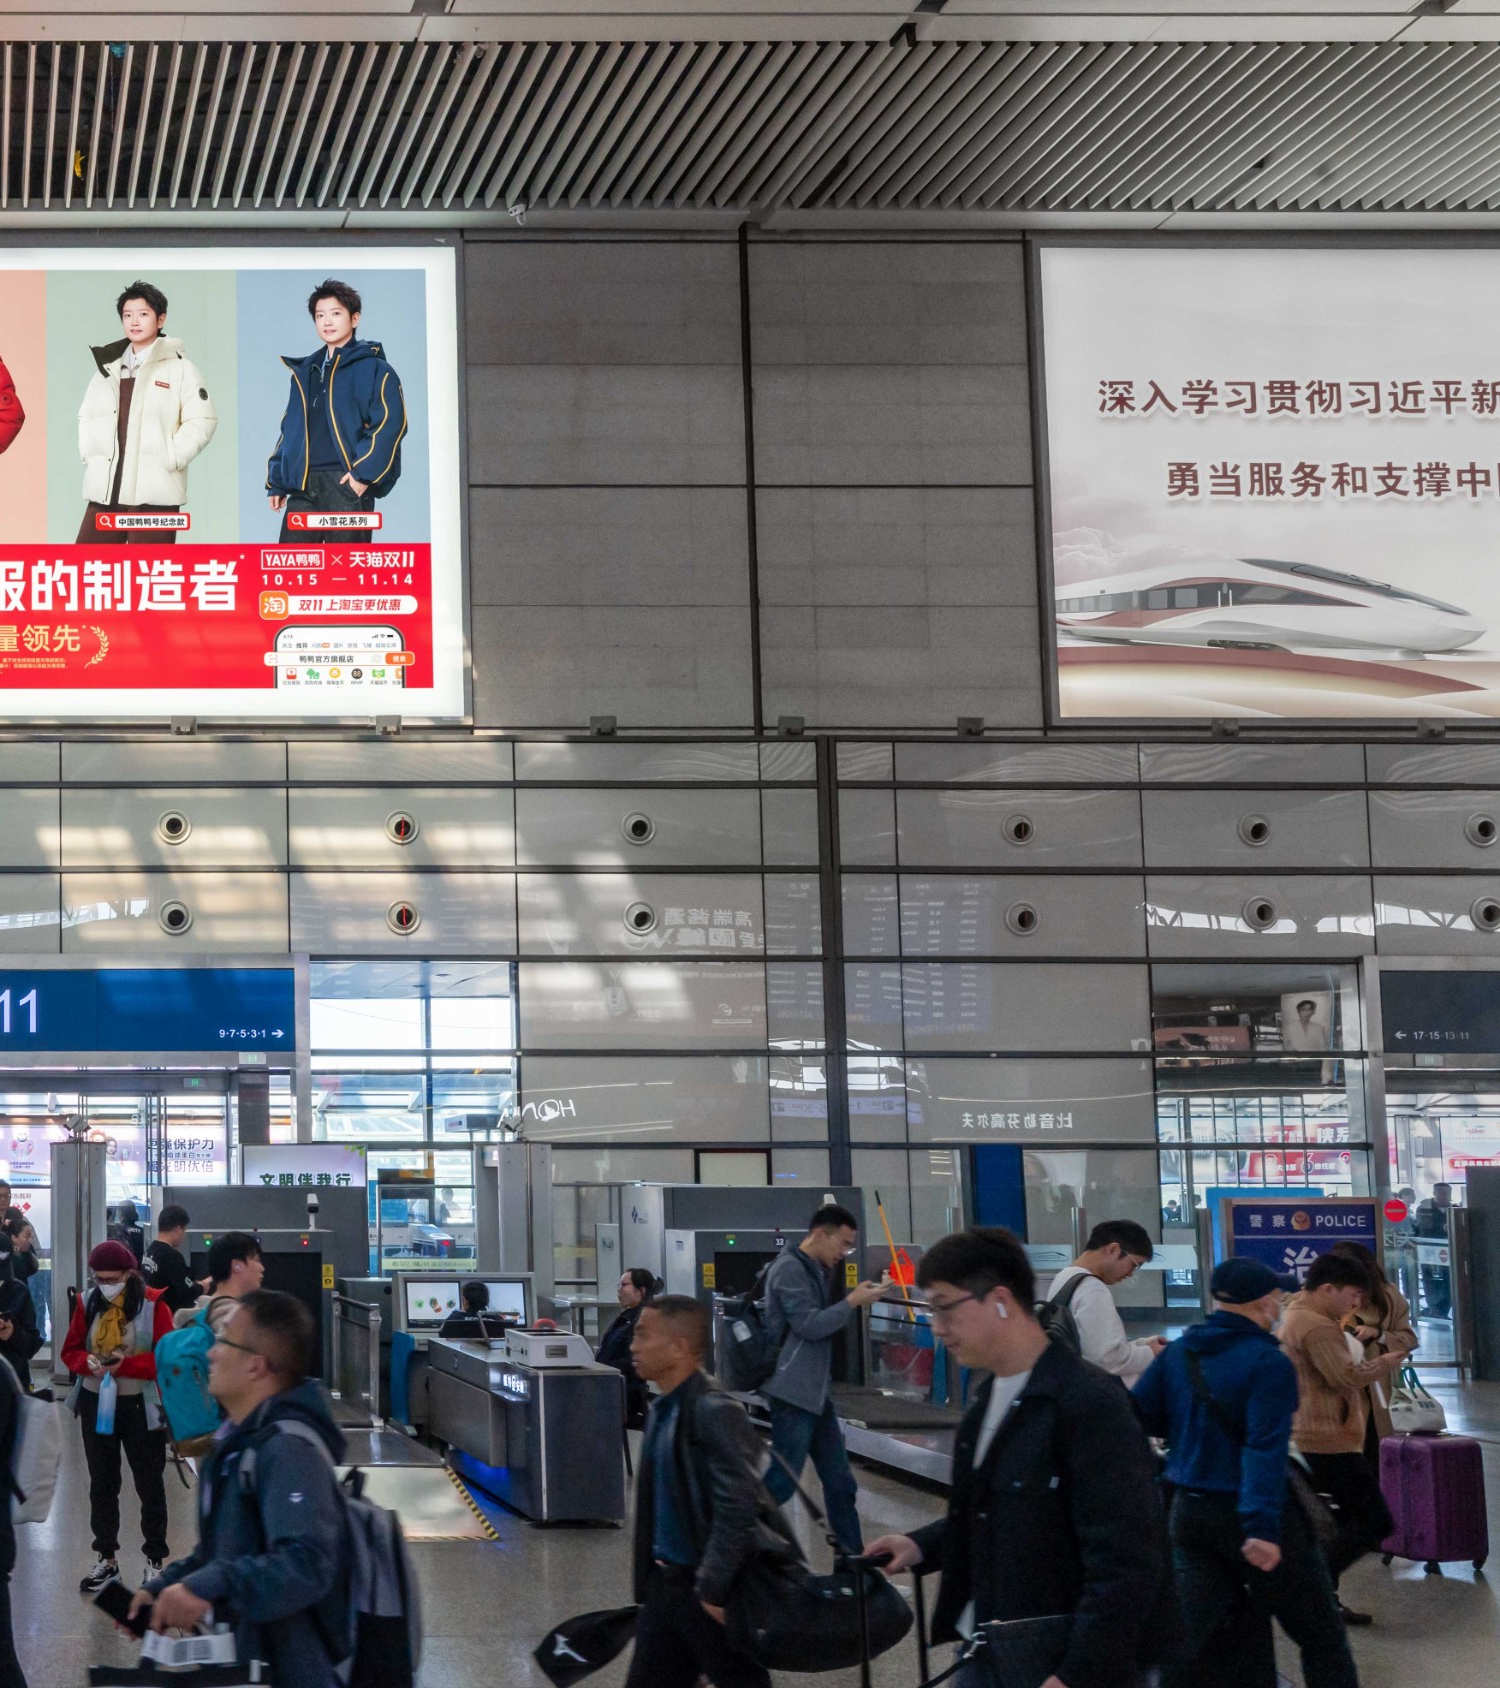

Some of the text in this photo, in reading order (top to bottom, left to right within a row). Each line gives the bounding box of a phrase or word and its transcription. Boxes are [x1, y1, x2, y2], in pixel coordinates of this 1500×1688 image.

[1166, 462, 1500, 498] 勇当服务和支撑中
[118, 517, 185, 527] 中国鸭鸭号纪念款
[318, 516, 368, 527] 小雪花系列
[265, 551, 415, 568] YAYA鸭鸭 天猫双11
[263, 596, 286, 614] 淘
[299, 655, 354, 663] 鸭鸭官方旗舰店
[259, 1173, 351, 1186] 文明伴我行
[1250, 1215, 1366, 1227] 警察 POLICE
[775, 1238, 784, 1246] 32
